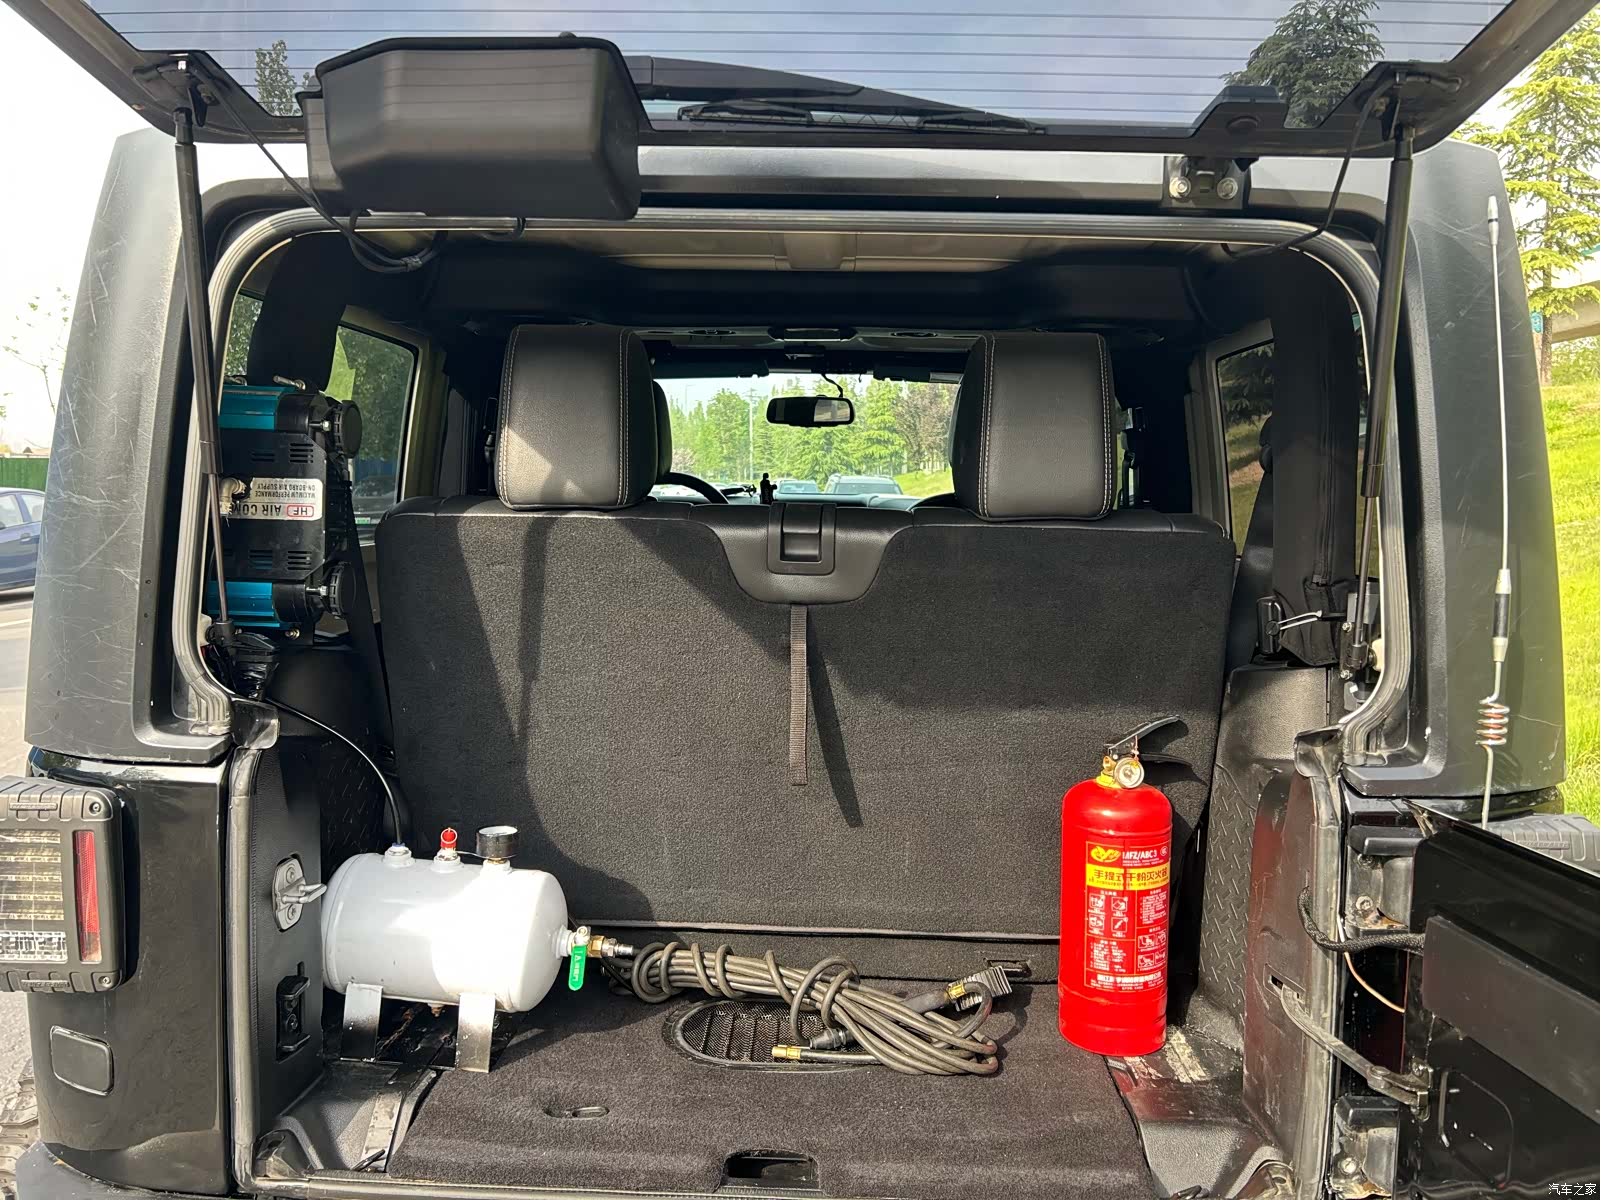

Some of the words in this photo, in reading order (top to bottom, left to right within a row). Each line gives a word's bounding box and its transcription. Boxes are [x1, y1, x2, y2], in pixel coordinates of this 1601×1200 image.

[279, 483, 288, 491] AIR
[255, 490, 290, 498] PERFORMANCE
[262, 504, 282, 516] AIR
[293, 508, 308, 516] HF
